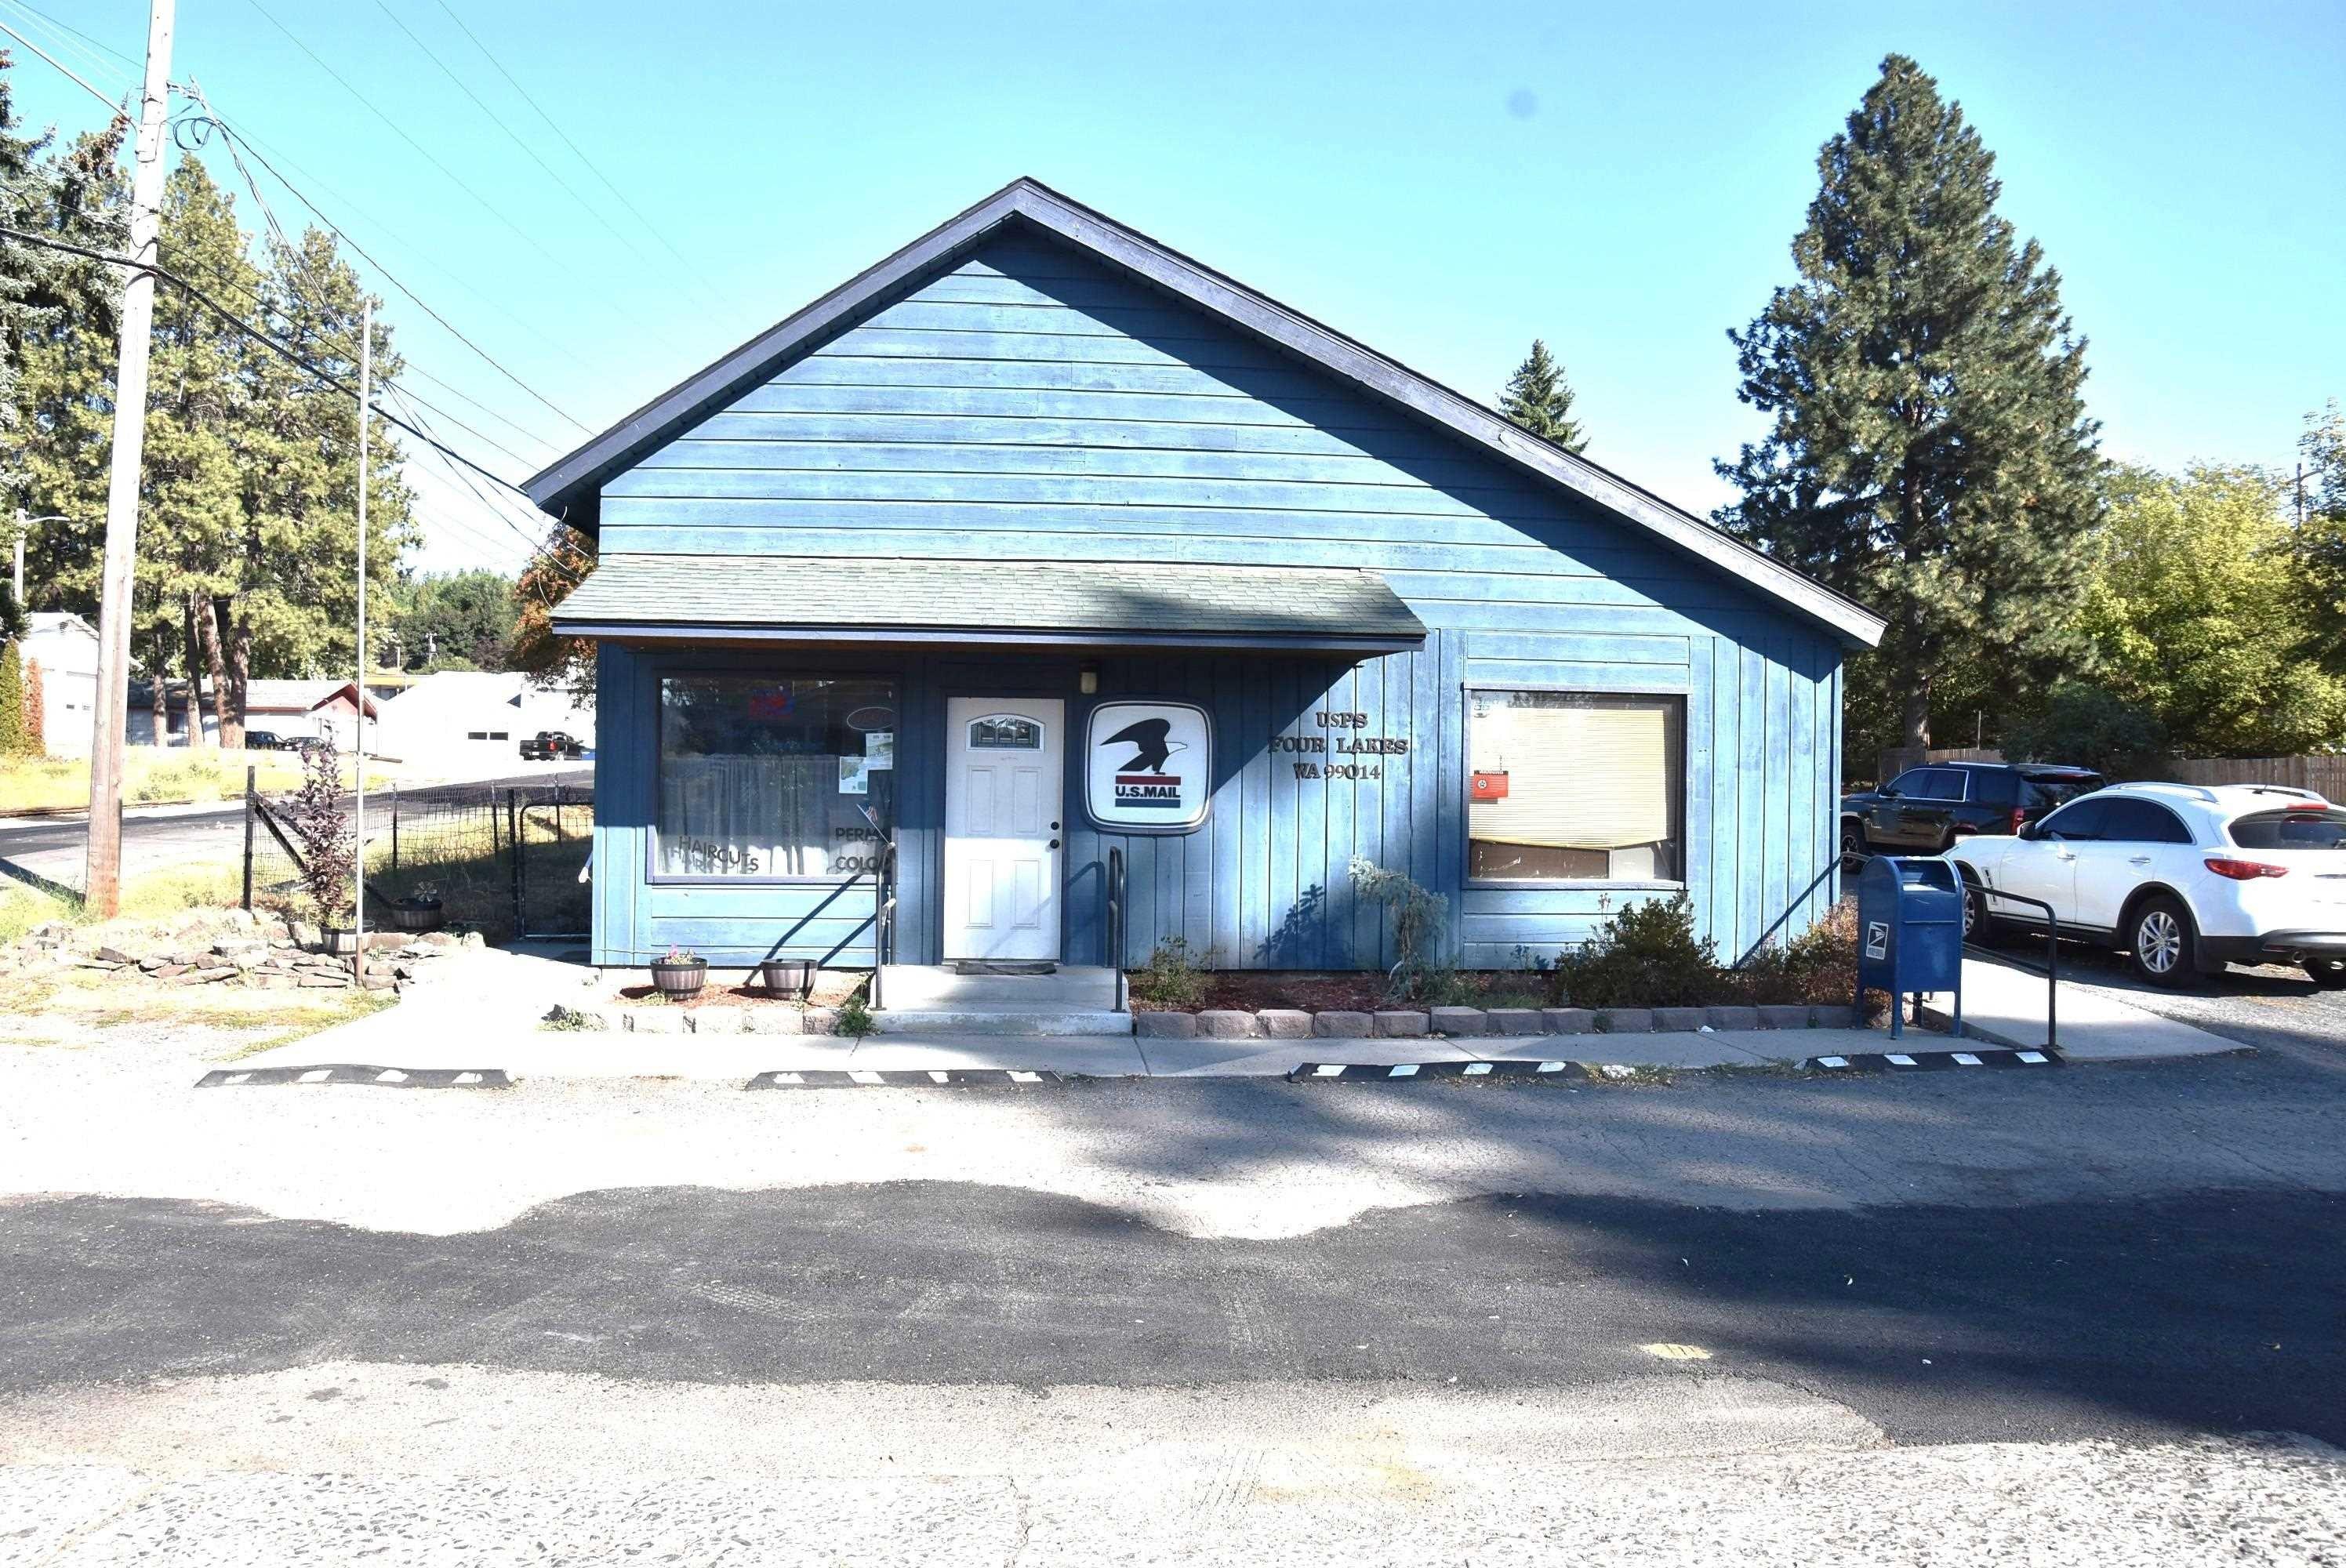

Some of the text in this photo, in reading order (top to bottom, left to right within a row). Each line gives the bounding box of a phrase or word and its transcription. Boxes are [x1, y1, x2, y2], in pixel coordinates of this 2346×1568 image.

[1316, 711, 1368, 729] USPS
[1268, 735, 1409, 754] FOUR LAKES
[1293, 762, 1381, 780] WA 99014
[678, 836, 760, 872] HAIRCUTS
